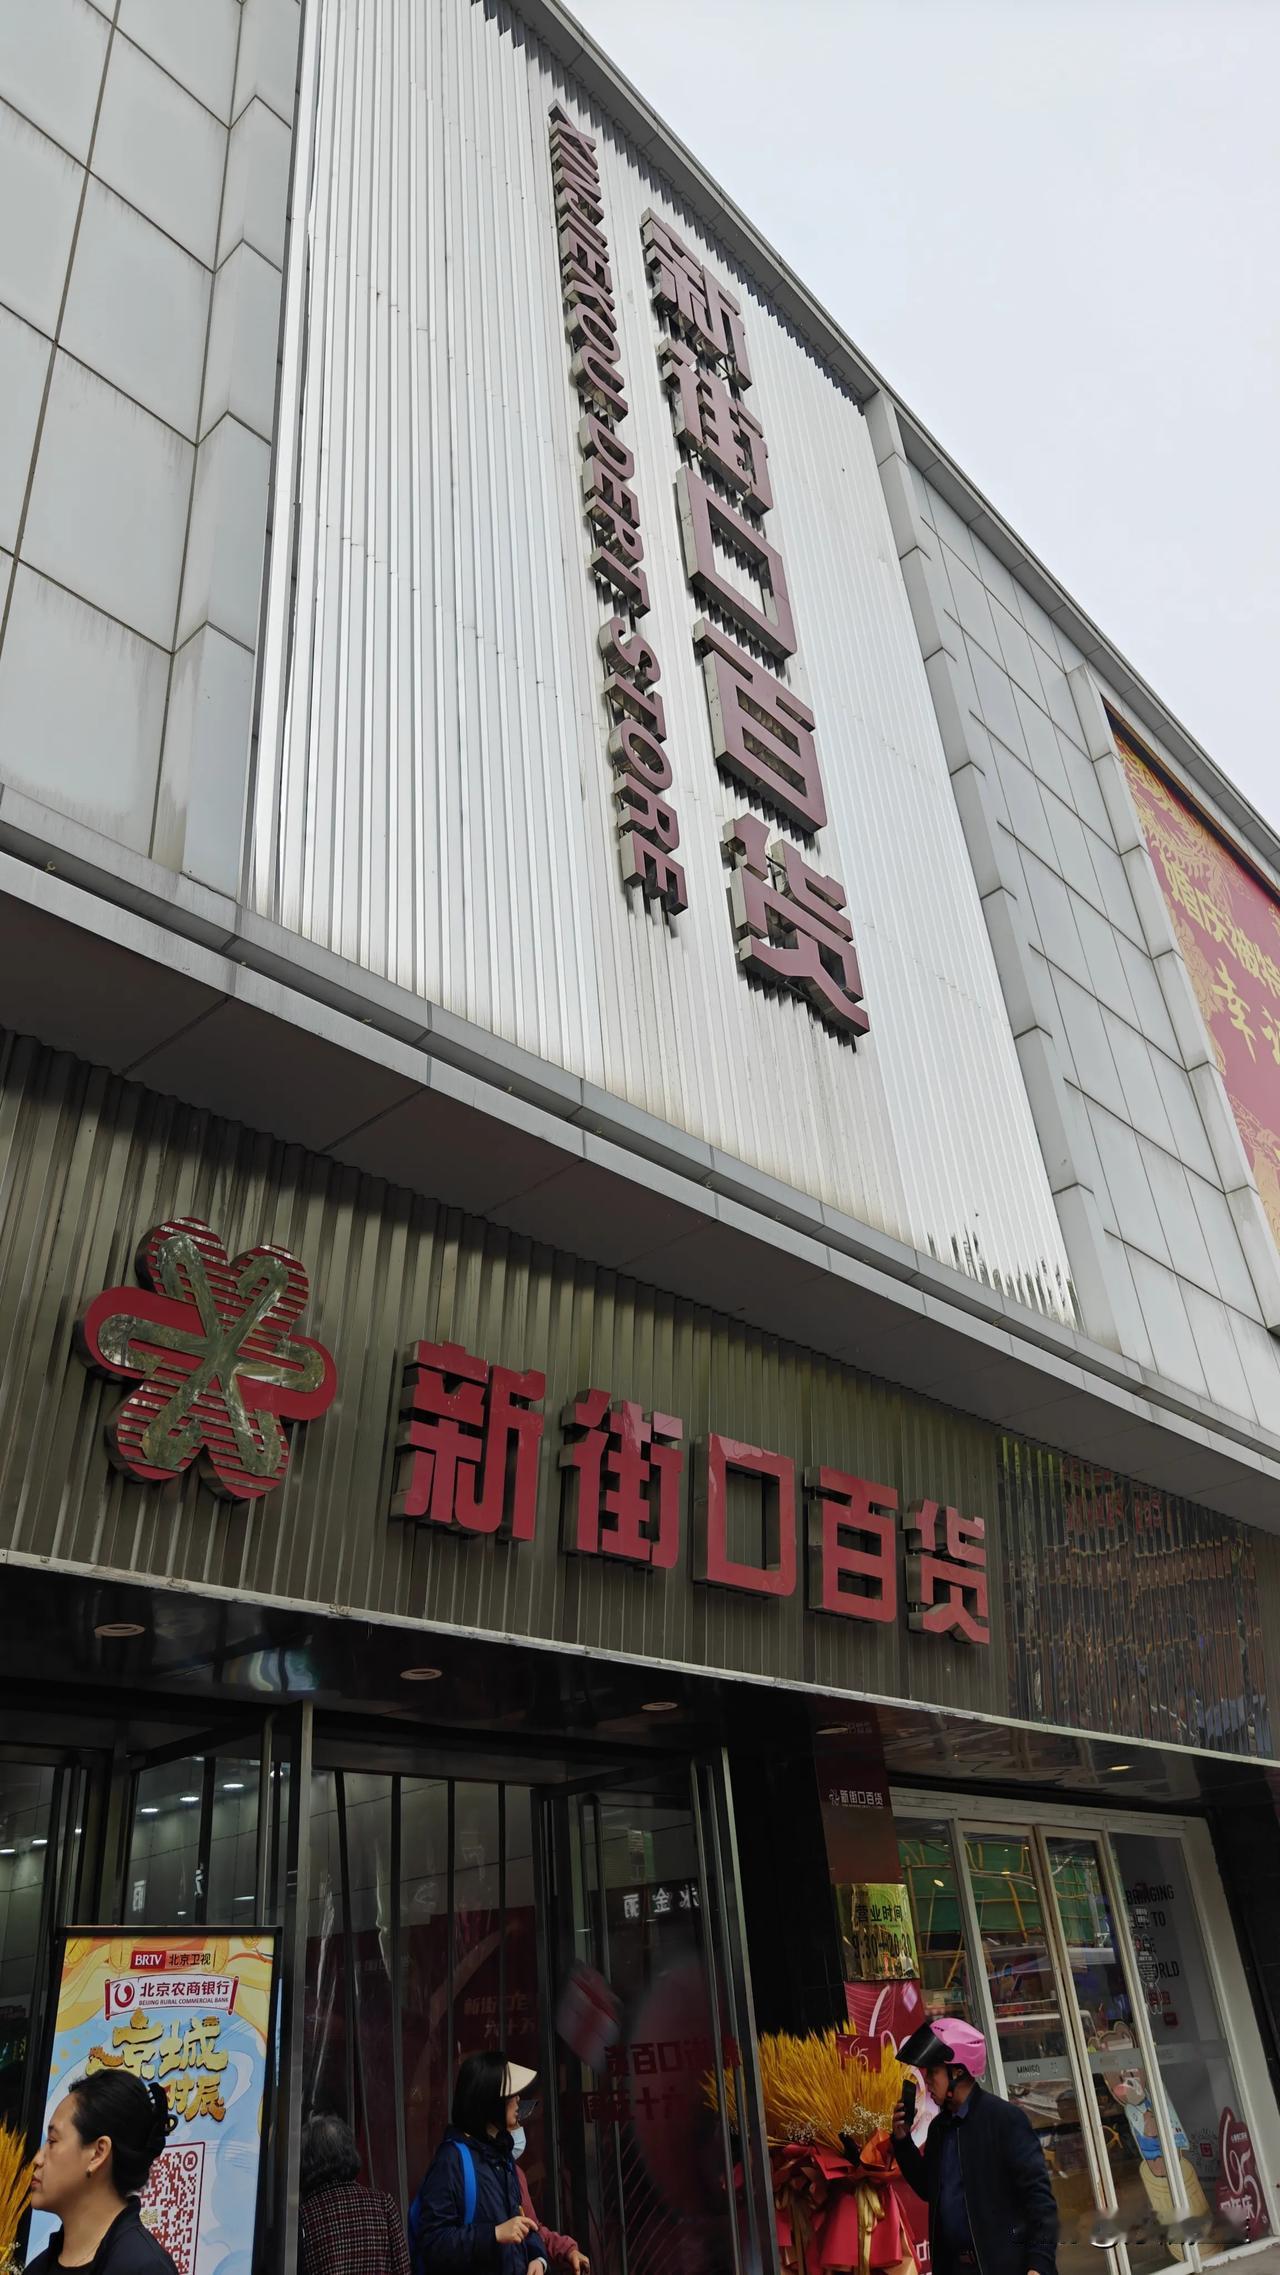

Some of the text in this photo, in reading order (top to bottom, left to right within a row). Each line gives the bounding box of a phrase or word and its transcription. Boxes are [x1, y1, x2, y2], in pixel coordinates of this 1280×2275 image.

[577, 413, 651, 618] DEPT
[641, 207, 870, 1038] 新街口百货
[600, 616, 688, 916] STORE
[394, 1338, 990, 1645] 新街口百货
[840, 1789, 884, 1806] 新街口百货
[856, 1903, 904, 1923] 营业时间
[134, 1953, 163, 1967] BRTV
[168, 1952, 211, 1966] 北京卫视
[140, 1980, 230, 1998] 北京农商银行
